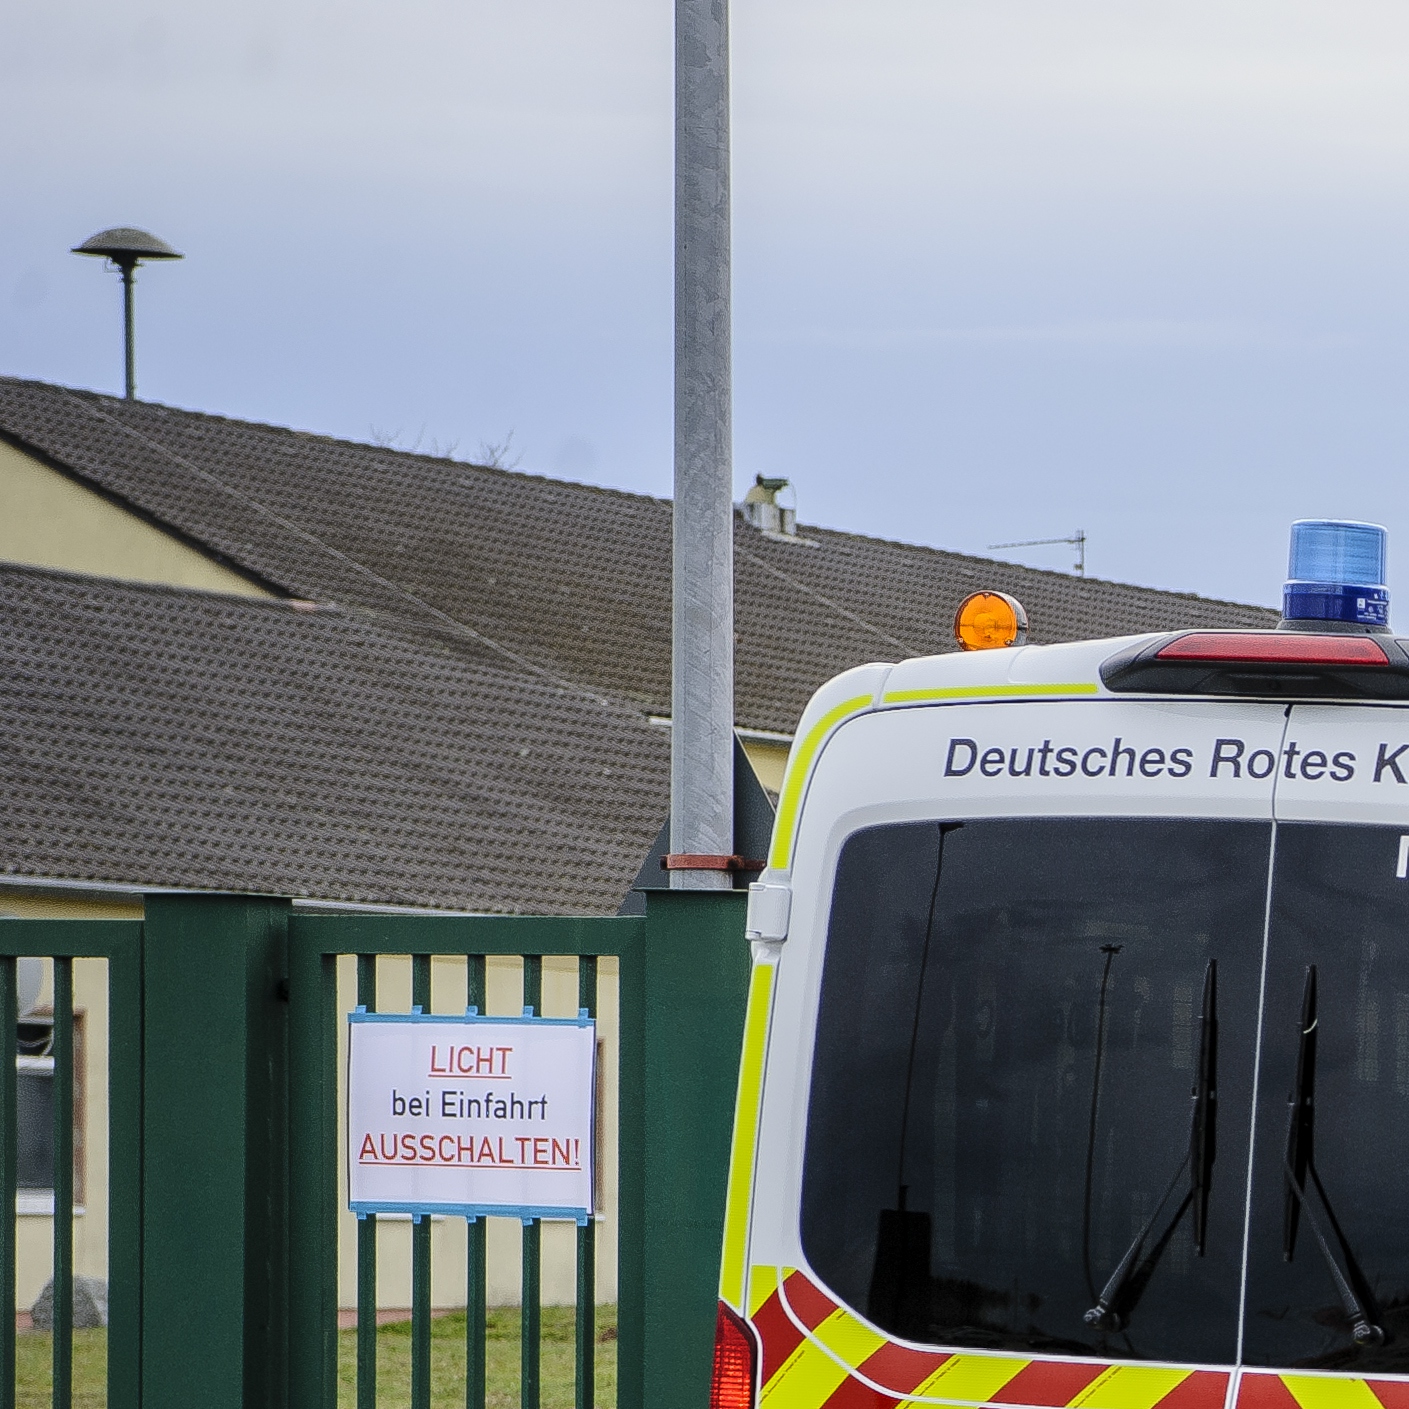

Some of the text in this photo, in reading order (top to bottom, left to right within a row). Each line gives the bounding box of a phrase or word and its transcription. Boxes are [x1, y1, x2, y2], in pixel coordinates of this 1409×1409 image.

[943, 737, 1194, 778] Deutsches
[1209, 738, 1356, 784] Rotes
[430, 1045, 513, 1075] LICHT
[392, 1089, 548, 1121] bei Einfahrt
[358, 1133, 580, 1166] AUSSCHALTEN!
